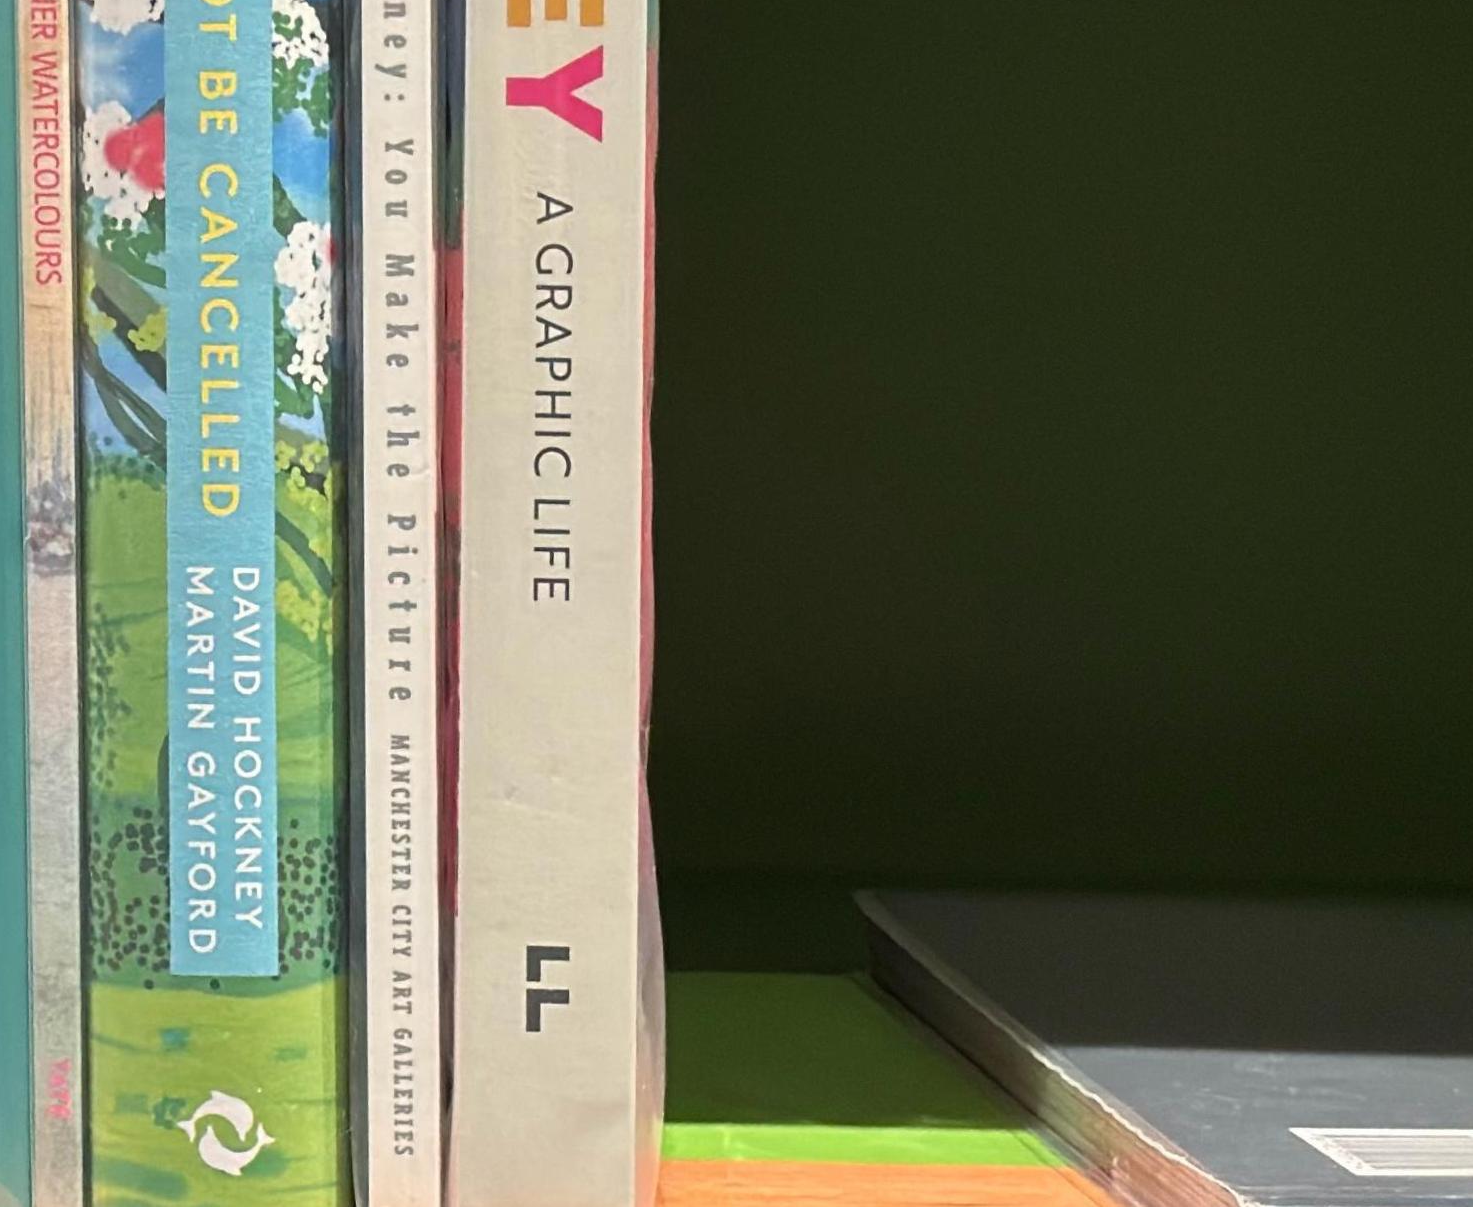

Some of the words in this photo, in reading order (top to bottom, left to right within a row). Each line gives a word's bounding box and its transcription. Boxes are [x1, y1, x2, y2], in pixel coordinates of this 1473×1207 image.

[198, 70, 239, 135] BE
[30, 50, 62, 287] WATERCOLOURS
[384, 138, 415, 218] You
[535, 190, 574, 226] A
[199, 163, 241, 517] CANCELLED
[385, 253, 419, 369] Make
[532, 243, 574, 479] GRAPHIC
[386, 403, 421, 478] the
[387, 513, 419, 702] Picture
[532, 497, 571, 602] LIFE
[185, 565, 216, 730] MARTIN
[232, 566, 261, 695] DAVID
[186, 751, 218, 954] GAYFORD
[233, 717, 263, 931] HOCKNEY
[389, 733, 412, 892] MANCHESTER
[391, 903, 413, 958] CITY
[392, 969, 413, 1015] ART
[393, 1027, 415, 1157] GALLERIES
